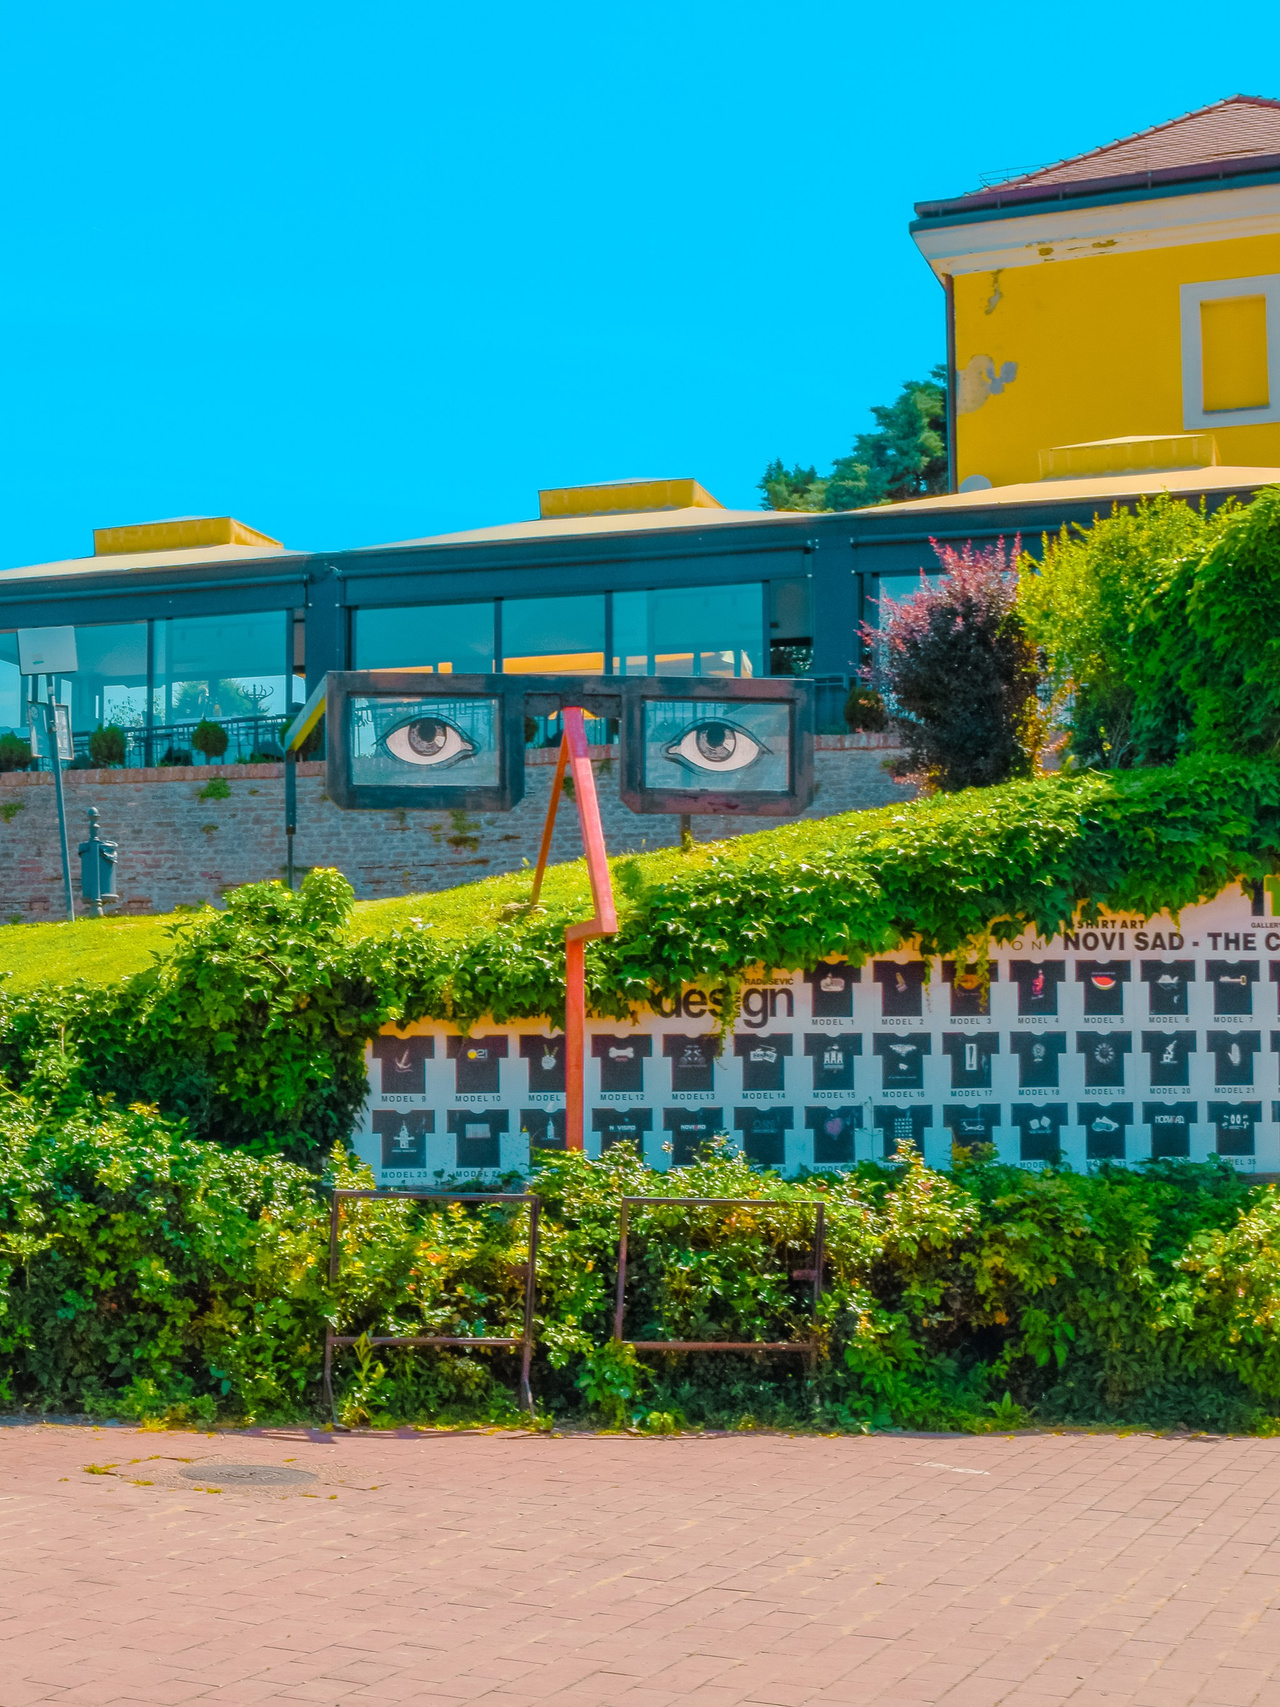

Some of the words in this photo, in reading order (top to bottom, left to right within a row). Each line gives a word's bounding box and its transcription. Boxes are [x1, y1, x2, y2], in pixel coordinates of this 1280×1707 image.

[1120, 920, 1145, 929] ART
[1063, 931, 1125, 951] NOVI
[1134, 931, 1185, 952] SAD
[1207, 932, 1257, 951] THE
[744, 978, 794, 986] RADSEVIC
[658, 986, 795, 1029] desgn
[811, 1018, 843, 1026] MODEL
[881, 1018, 914, 1026] MODEL
[949, 1017, 980, 1025] MODEL
[1083, 1016, 1113, 1024] MODEL
[1148, 1016, 1180, 1024] MODEL
[1213, 1016, 1245, 1024] MODEL
[882, 1090, 913, 1098] MODEL
[950, 1089, 981, 1097] MODEL
[1018, 1088, 1048, 1096] MODEL
[1084, 1088, 1115, 1096] MODEL
[1149, 1087, 1179, 1095] MODEL
[1214, 1086, 1243, 1094] MODEL
[381, 1095, 415, 1103] MODEL
[454, 1095, 487, 1103] MODEL
[528, 1094, 562, 1102] MODEL
[600, 1093, 633, 1101] MODEL
[671, 1093, 704, 1101] MODEL
[741, 1092, 775, 1100] MODEL
[812, 1091, 844, 1099] MODEL
[813, 1165, 843, 1173] MODE
[381, 1171, 415, 1179] MODEL
